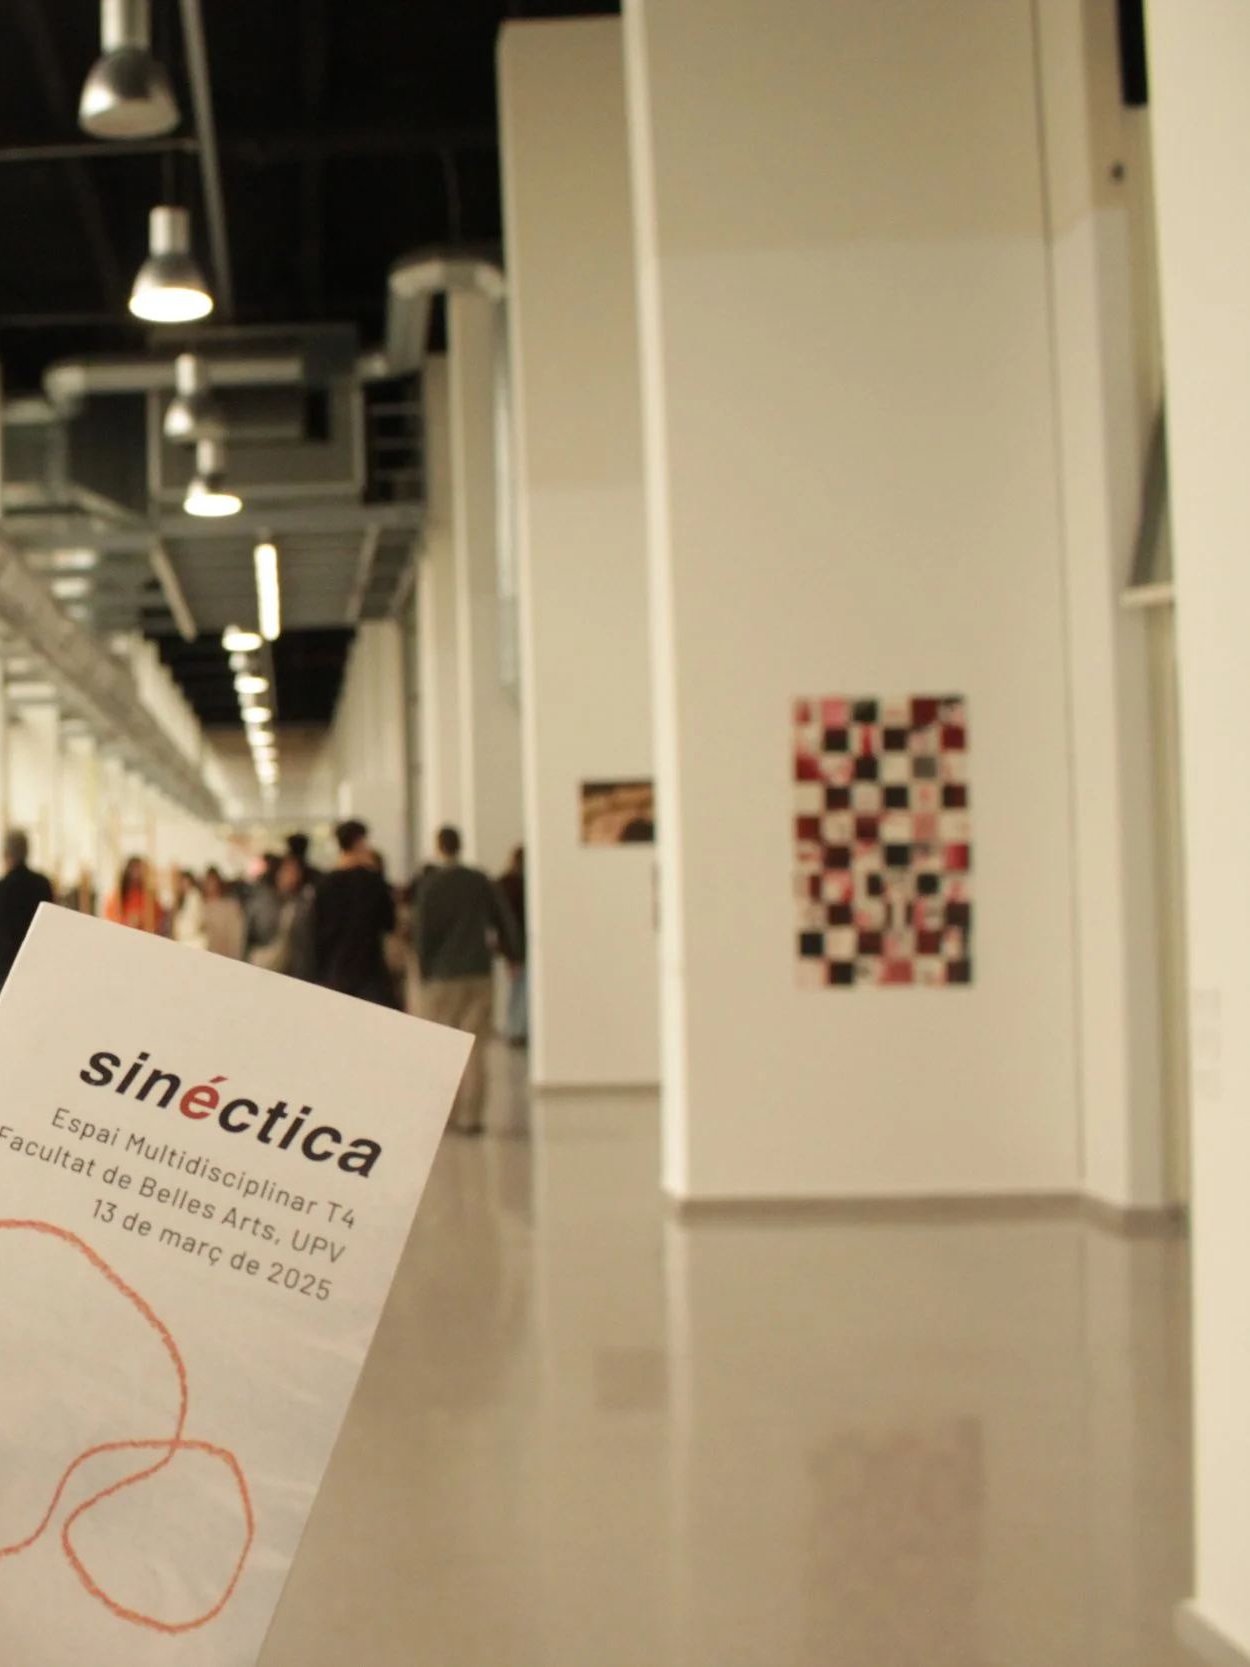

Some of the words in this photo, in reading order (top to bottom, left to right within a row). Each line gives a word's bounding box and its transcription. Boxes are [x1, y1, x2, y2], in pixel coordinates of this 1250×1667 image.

[52, 1108, 119, 1147] Espai
[125, 1133, 318, 1216] Multidisciplinar
[327, 1202, 356, 1230] T4
[79, 1050, 382, 1178] sinéctica
[91, 1199, 118, 1223] 13
[122, 1213, 153, 1237] de
[159, 1227, 223, 1265] març
[230, 1252, 261, 1276] de
[267, 1262, 332, 1301] 2025
[102, 1166, 133, 1191] de
[139, 1177, 215, 1220] Belles
[221, 1207, 281, 1246] Arts,
[292, 1229, 347, 1264] UPV
